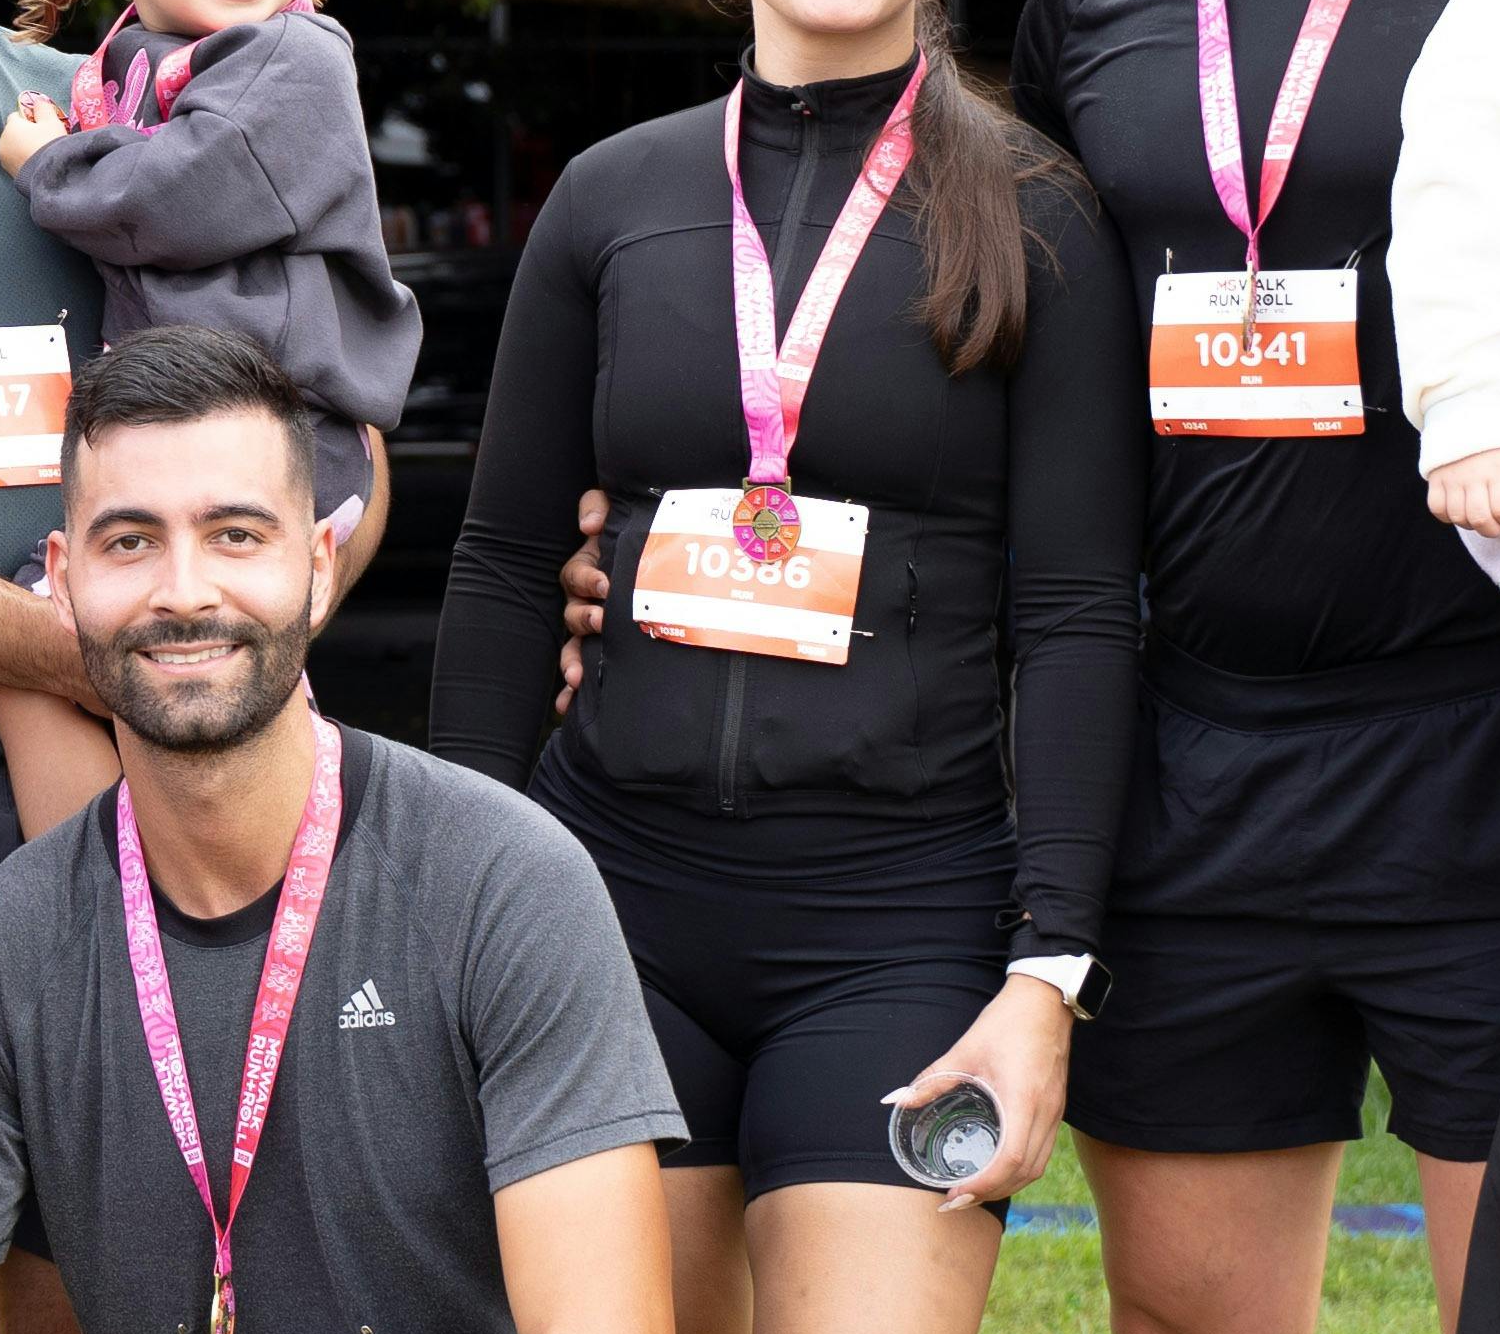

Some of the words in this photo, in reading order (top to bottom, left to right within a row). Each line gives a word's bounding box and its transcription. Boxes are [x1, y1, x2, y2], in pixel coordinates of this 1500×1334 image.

[1194, 331, 1307, 367] 10341
[1240, 375, 1263, 384] RUN
[1181, 421, 1208, 431] 10341
[1312, 421, 1342, 431] 10341
[338, 1009, 396, 1028] adidas
[263, 1038, 281, 1069] MS
[154, 1057, 180, 1119] WALK
[165, 1033, 199, 1146] RUN+ROLL
[236, 1033, 267, 1144] RUN+ROLL
[249, 1071, 274, 1131] WALK
[171, 1119, 190, 1149] MS
